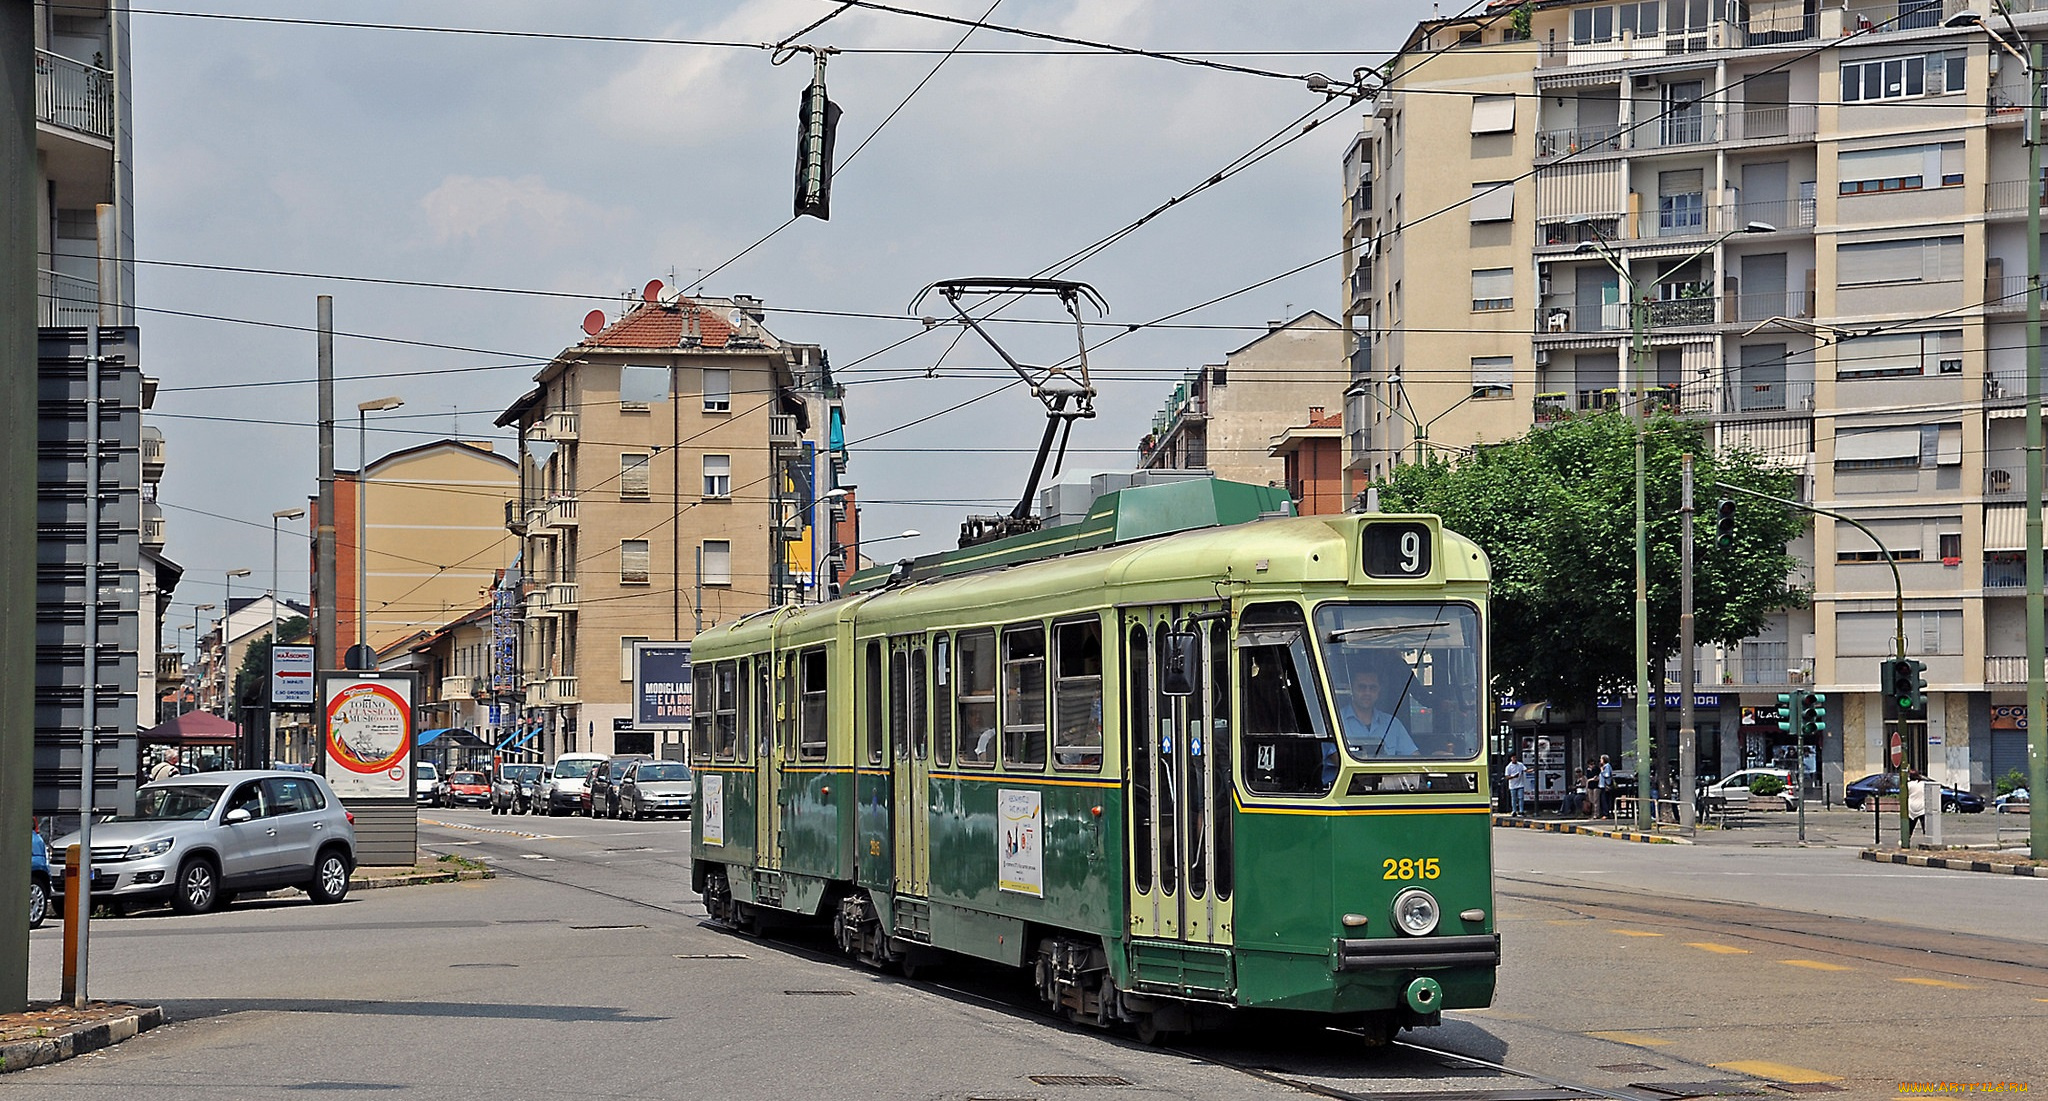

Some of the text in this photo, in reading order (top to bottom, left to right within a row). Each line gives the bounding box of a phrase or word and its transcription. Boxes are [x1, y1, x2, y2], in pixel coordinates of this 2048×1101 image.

[1400, 531, 1420, 573] 9
[657, 695, 663, 705] E
[665, 695, 675, 705] LA
[1258, 745, 1275, 769] 21
[1383, 858, 1441, 880] 2815
